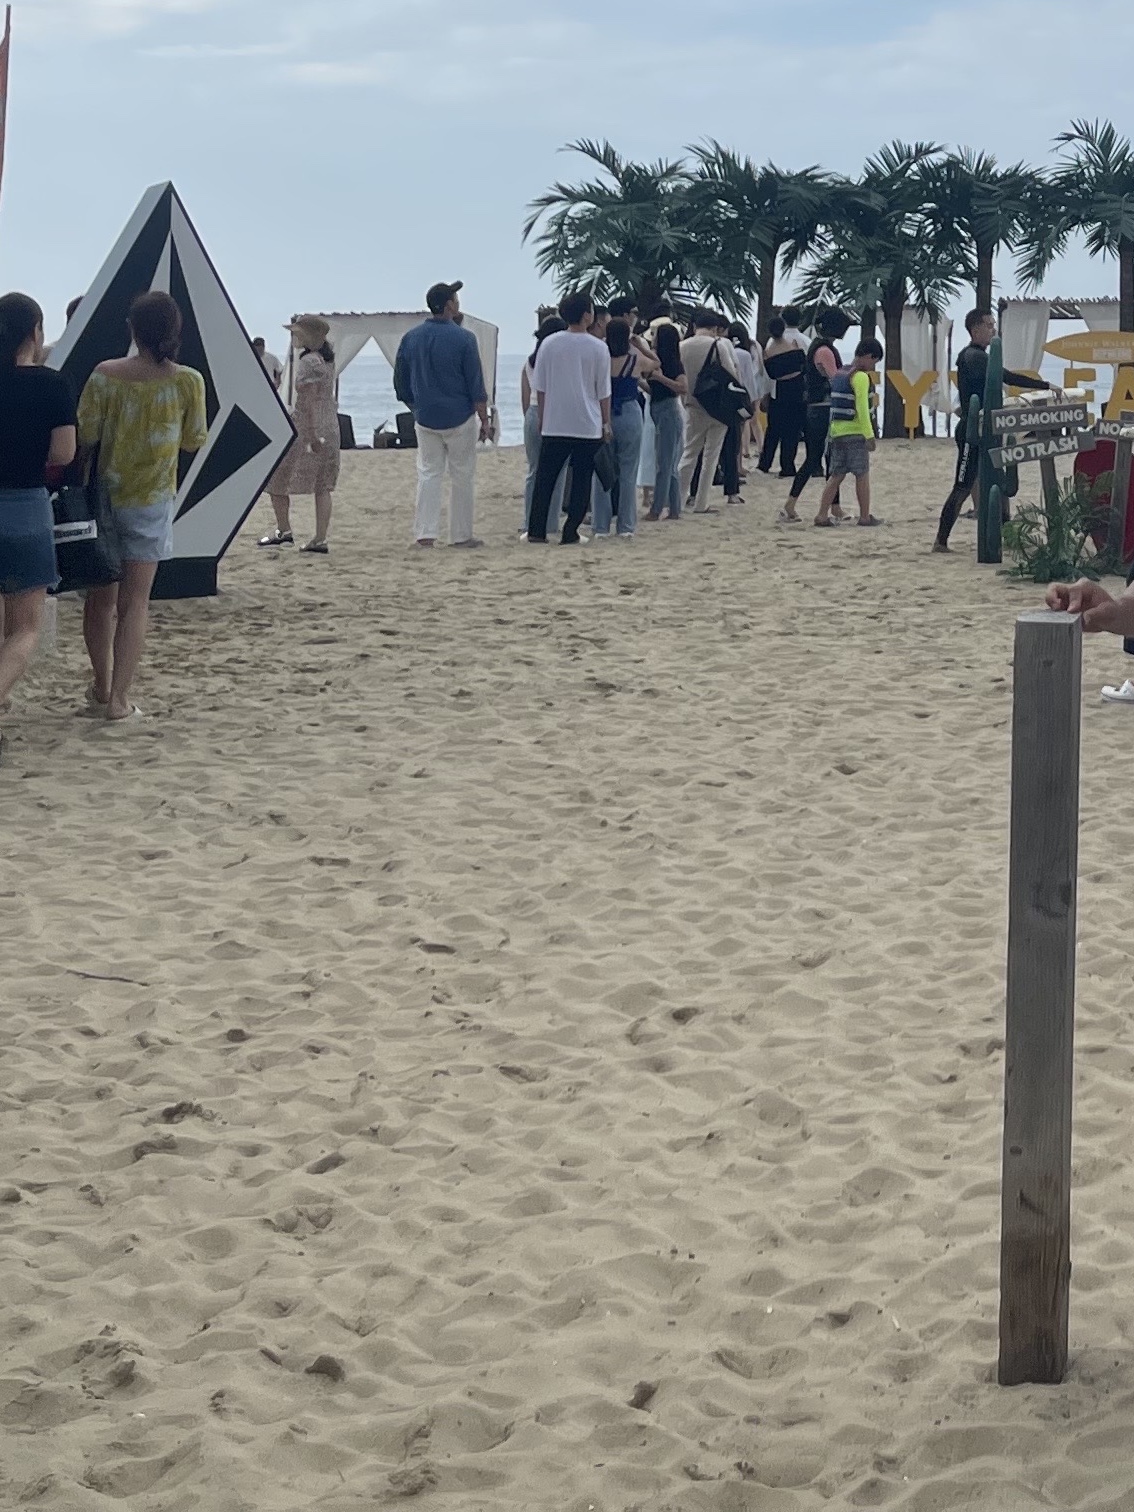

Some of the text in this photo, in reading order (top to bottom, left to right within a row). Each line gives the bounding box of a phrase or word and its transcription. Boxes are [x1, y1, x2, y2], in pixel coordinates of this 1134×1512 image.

[996, 409, 1084, 428] NO SMOKING
[1101, 422, 1120, 435] NO
[1001, 436, 1078, 463] NO TRASH
